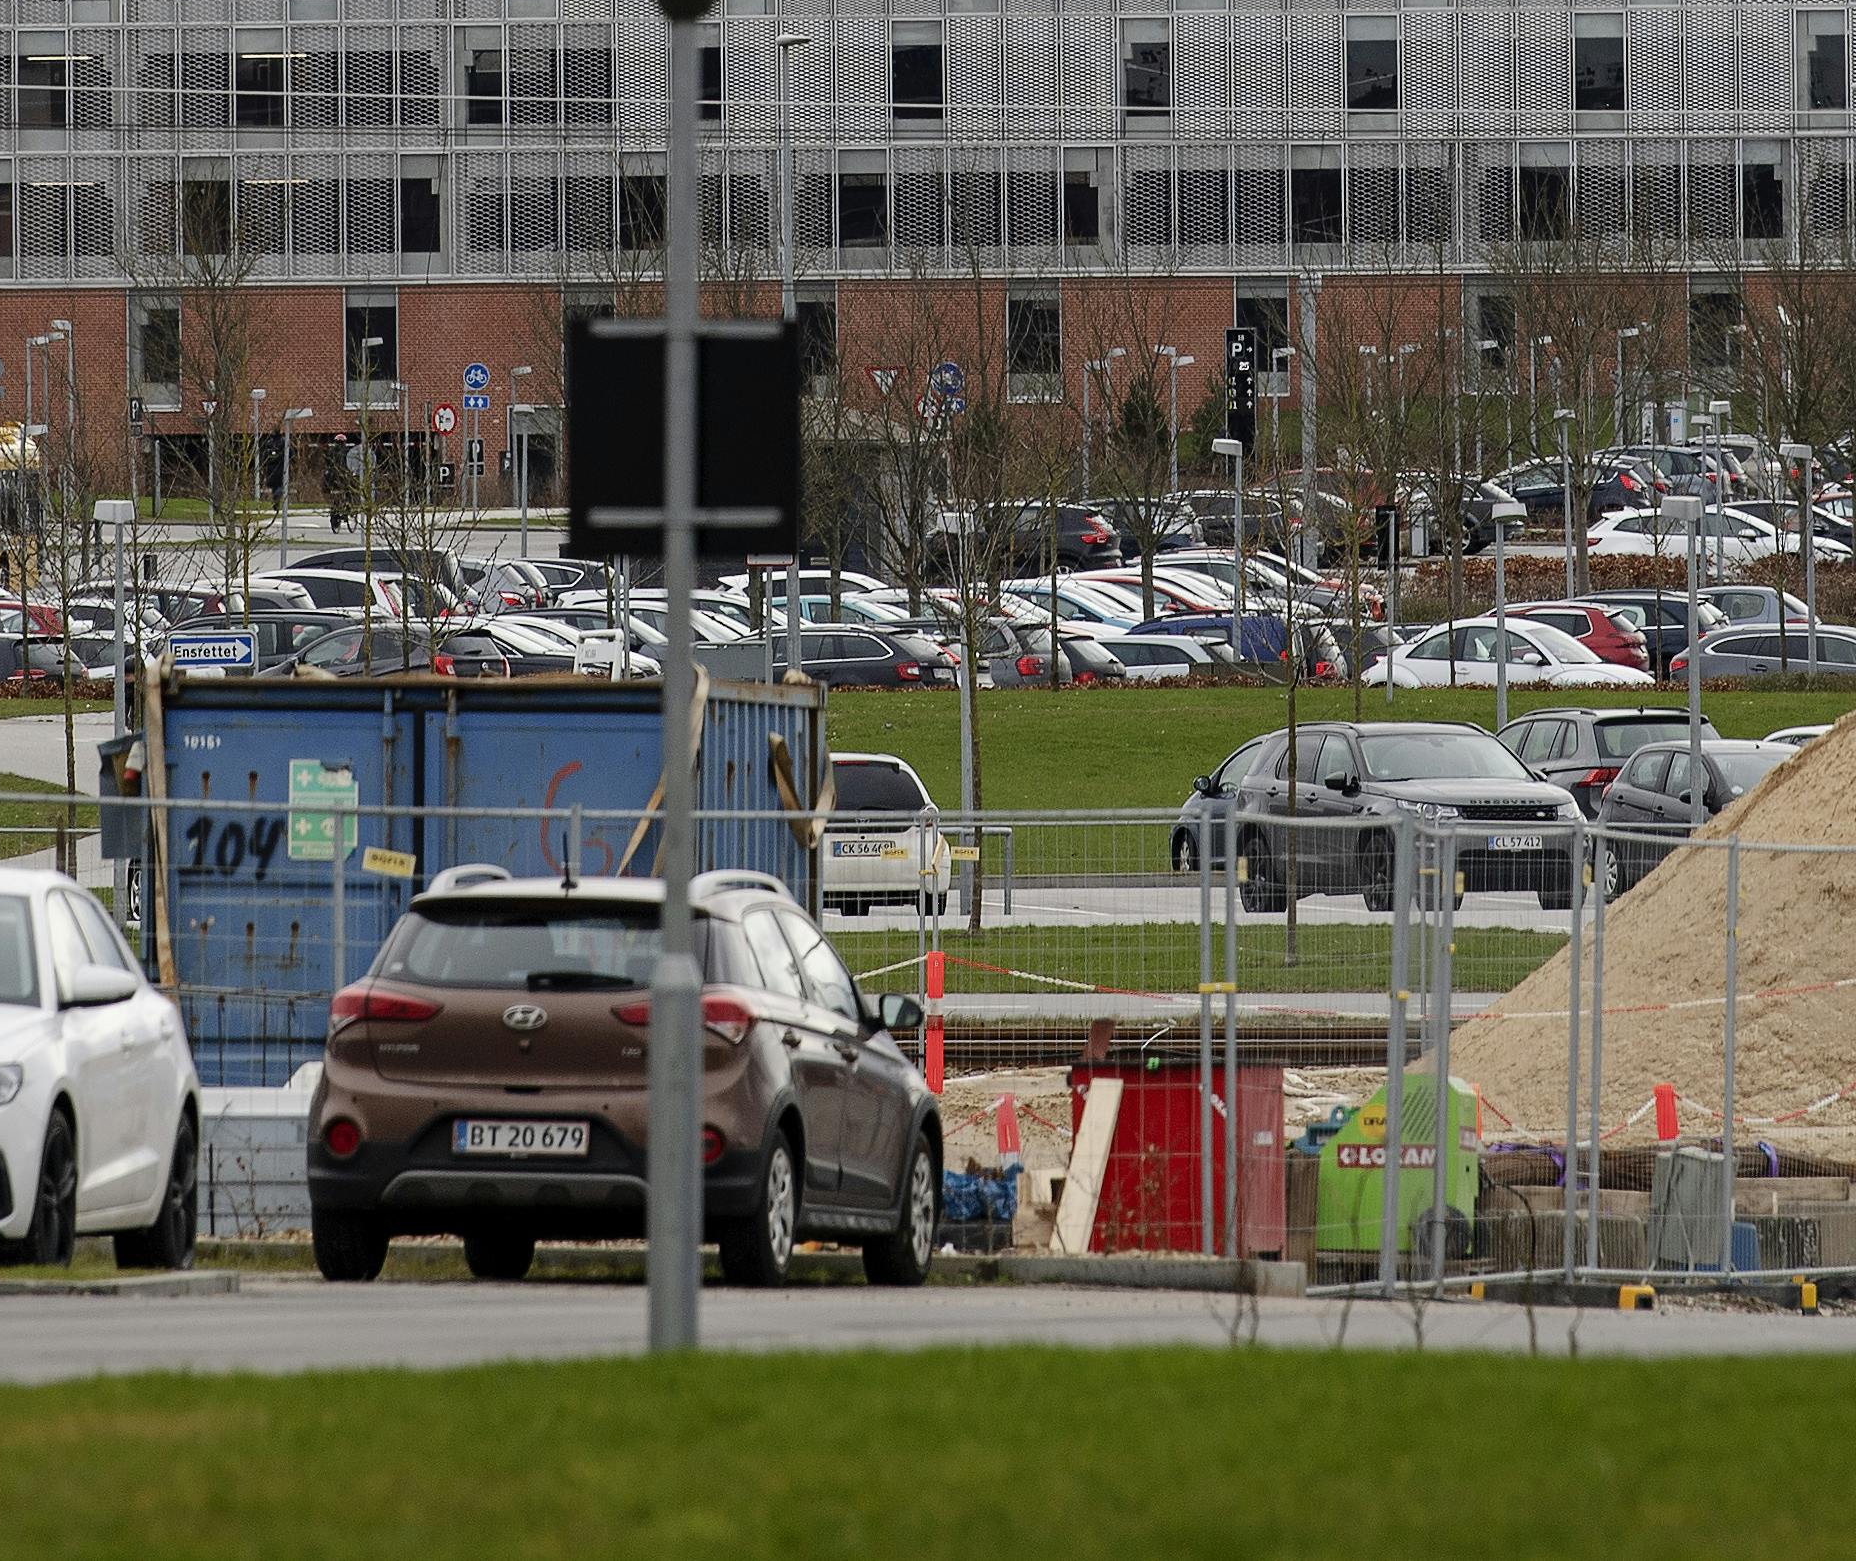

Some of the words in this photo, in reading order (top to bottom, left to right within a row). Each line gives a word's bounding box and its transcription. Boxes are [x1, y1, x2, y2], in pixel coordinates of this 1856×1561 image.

[1232, 342, 1243, 357] P
[439, 466, 450, 482] P
[174, 645, 237, 658] Ensrettet
[186, 815, 286, 880] 104
[842, 843, 855, 854] CK
[858, 843, 870, 854] 56
[1496, 838, 1506, 848] CL
[1511, 838, 1522, 848] 57
[1525, 838, 1541, 848] 412
[470, 1125, 502, 1147] BT
[508, 1126, 535, 1147] 20
[541, 1127, 584, 1148] 679
[1359, 1147, 1436, 1165] LOAM
